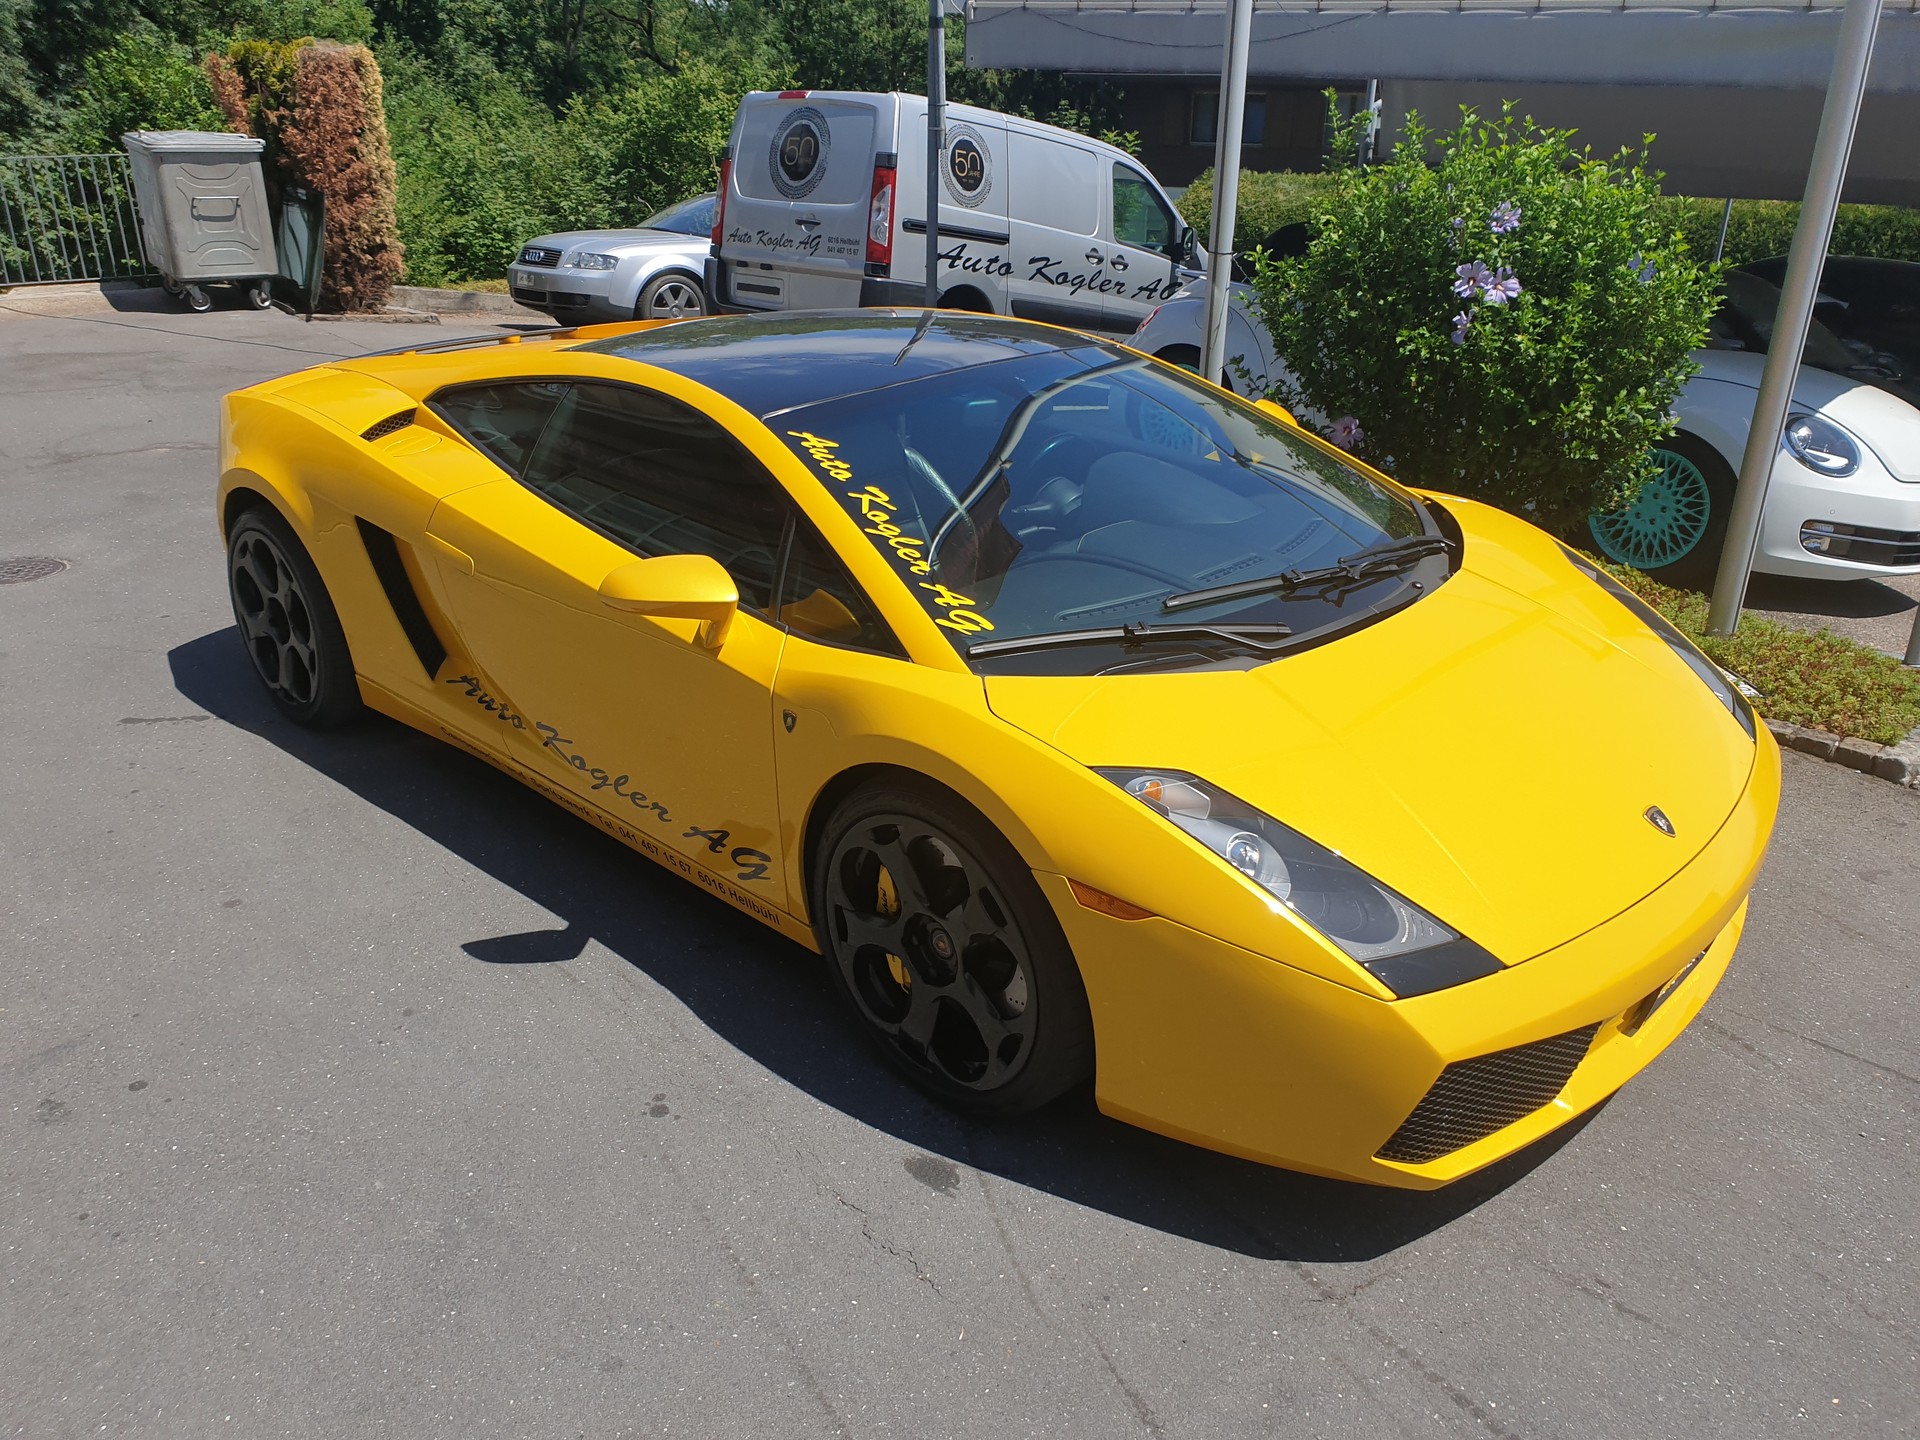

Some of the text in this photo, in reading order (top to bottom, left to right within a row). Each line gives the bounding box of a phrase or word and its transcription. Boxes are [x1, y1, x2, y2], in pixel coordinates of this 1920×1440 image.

[955, 149, 980, 177] 50
[727, 227, 822, 256] Auto Kogler AG
[937, 243, 1014, 276] Auto
[1028, 256, 1126, 296] Kogler
[787, 431, 995, 636] Auto Kogler AG
[446, 675, 527, 730] Auto
[536, 721, 673, 823] Kogler
[682, 826, 772, 881] AG
[595, 813, 618, 834] Tel.
[619, 826, 639, 845] 041
[640, 839, 660, 856] 467
[663, 851, 677, 866] 15
[679, 862, 692, 875] 67
[697, 871, 726, 894] 6016
[728, 887, 780, 926] Hellbühl
